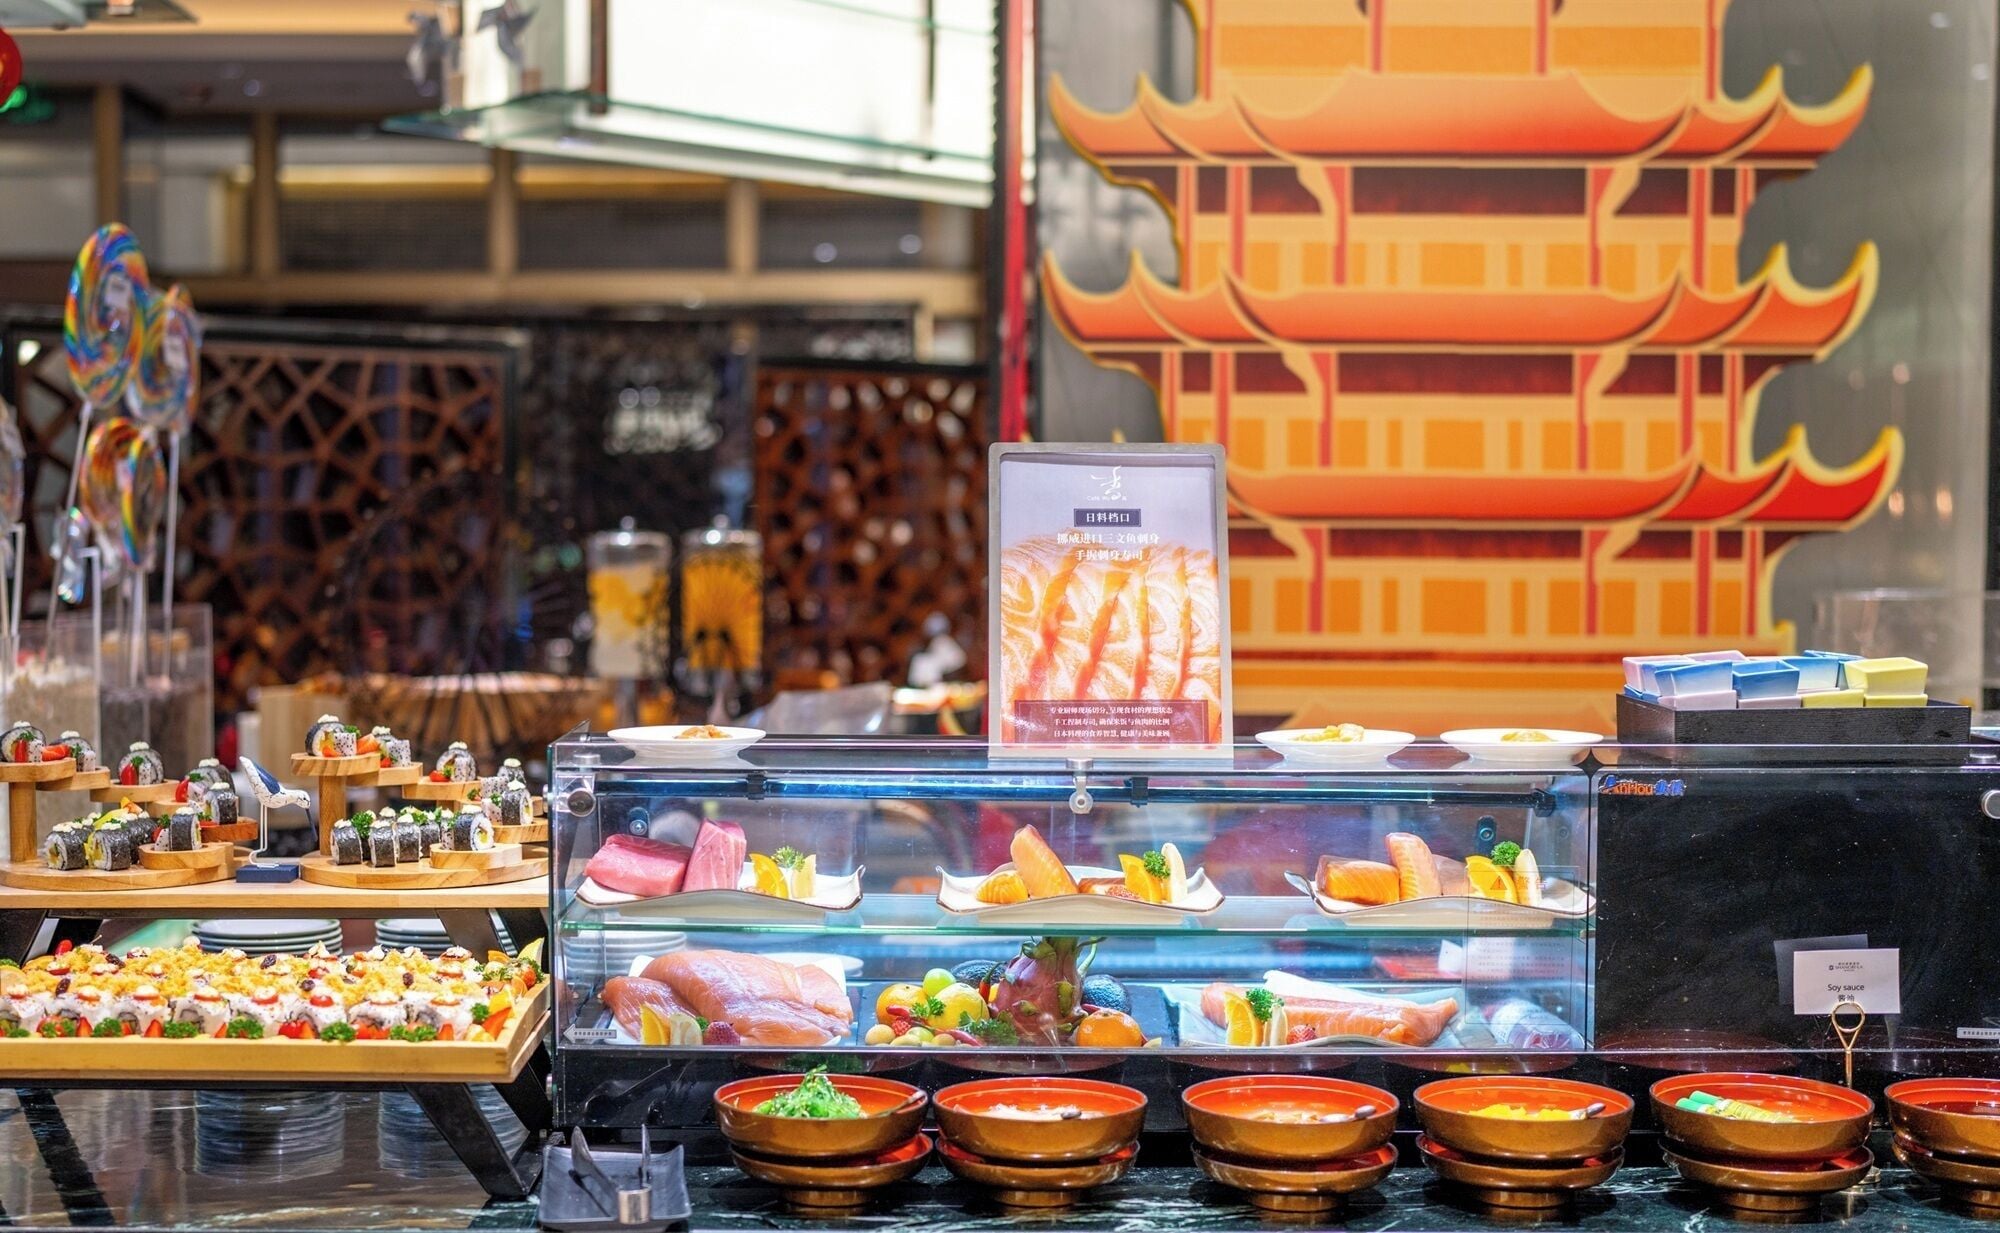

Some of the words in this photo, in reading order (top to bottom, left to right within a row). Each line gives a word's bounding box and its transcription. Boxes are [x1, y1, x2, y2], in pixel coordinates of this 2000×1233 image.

[1086, 512, 1130, 523] 日料档口
[1057, 533, 1159, 545] 挪威进口三文鱼刺身
[1076, 550, 1142, 561] 手握刺身寿司
[1827, 983, 1842, 992] Soy
